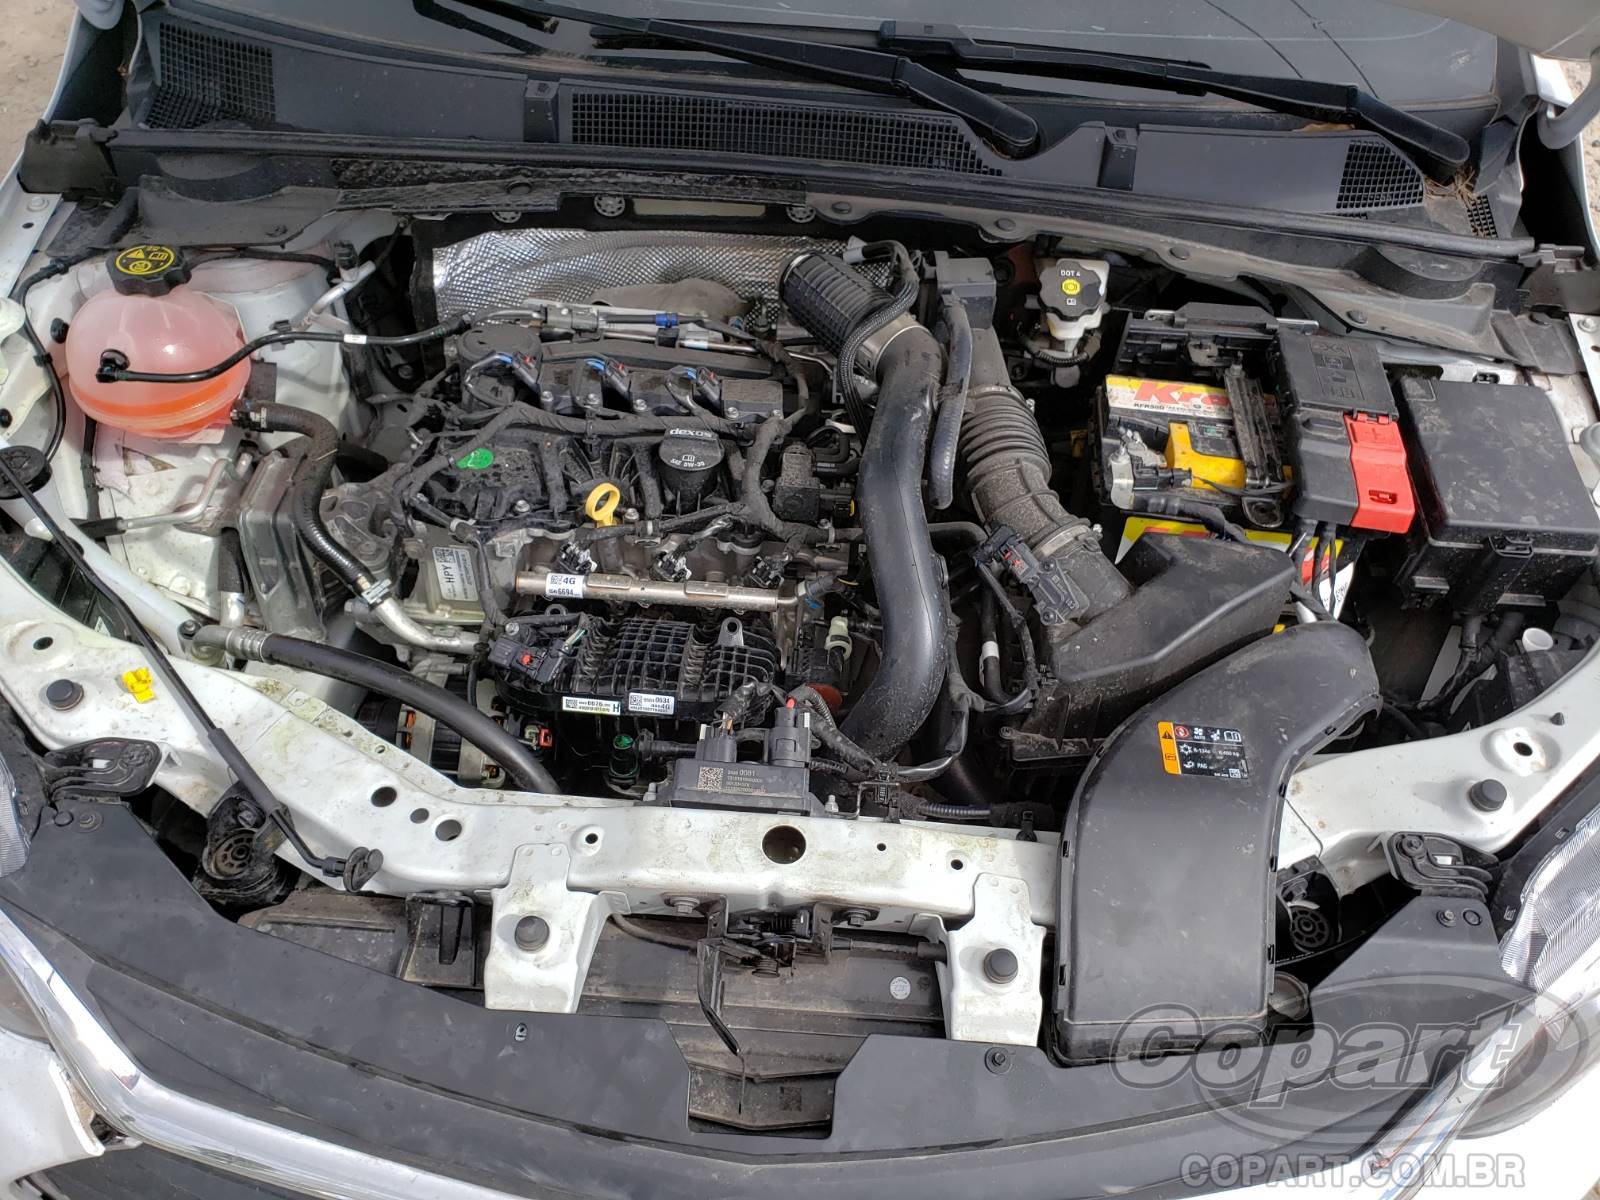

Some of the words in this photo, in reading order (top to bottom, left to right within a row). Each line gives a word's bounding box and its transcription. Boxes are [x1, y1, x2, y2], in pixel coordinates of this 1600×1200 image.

[670, 428, 712, 437] dexos
[441, 564, 456, 584] HPY
[562, 577, 576, 585] 4G
[612, 703, 620, 713] H
